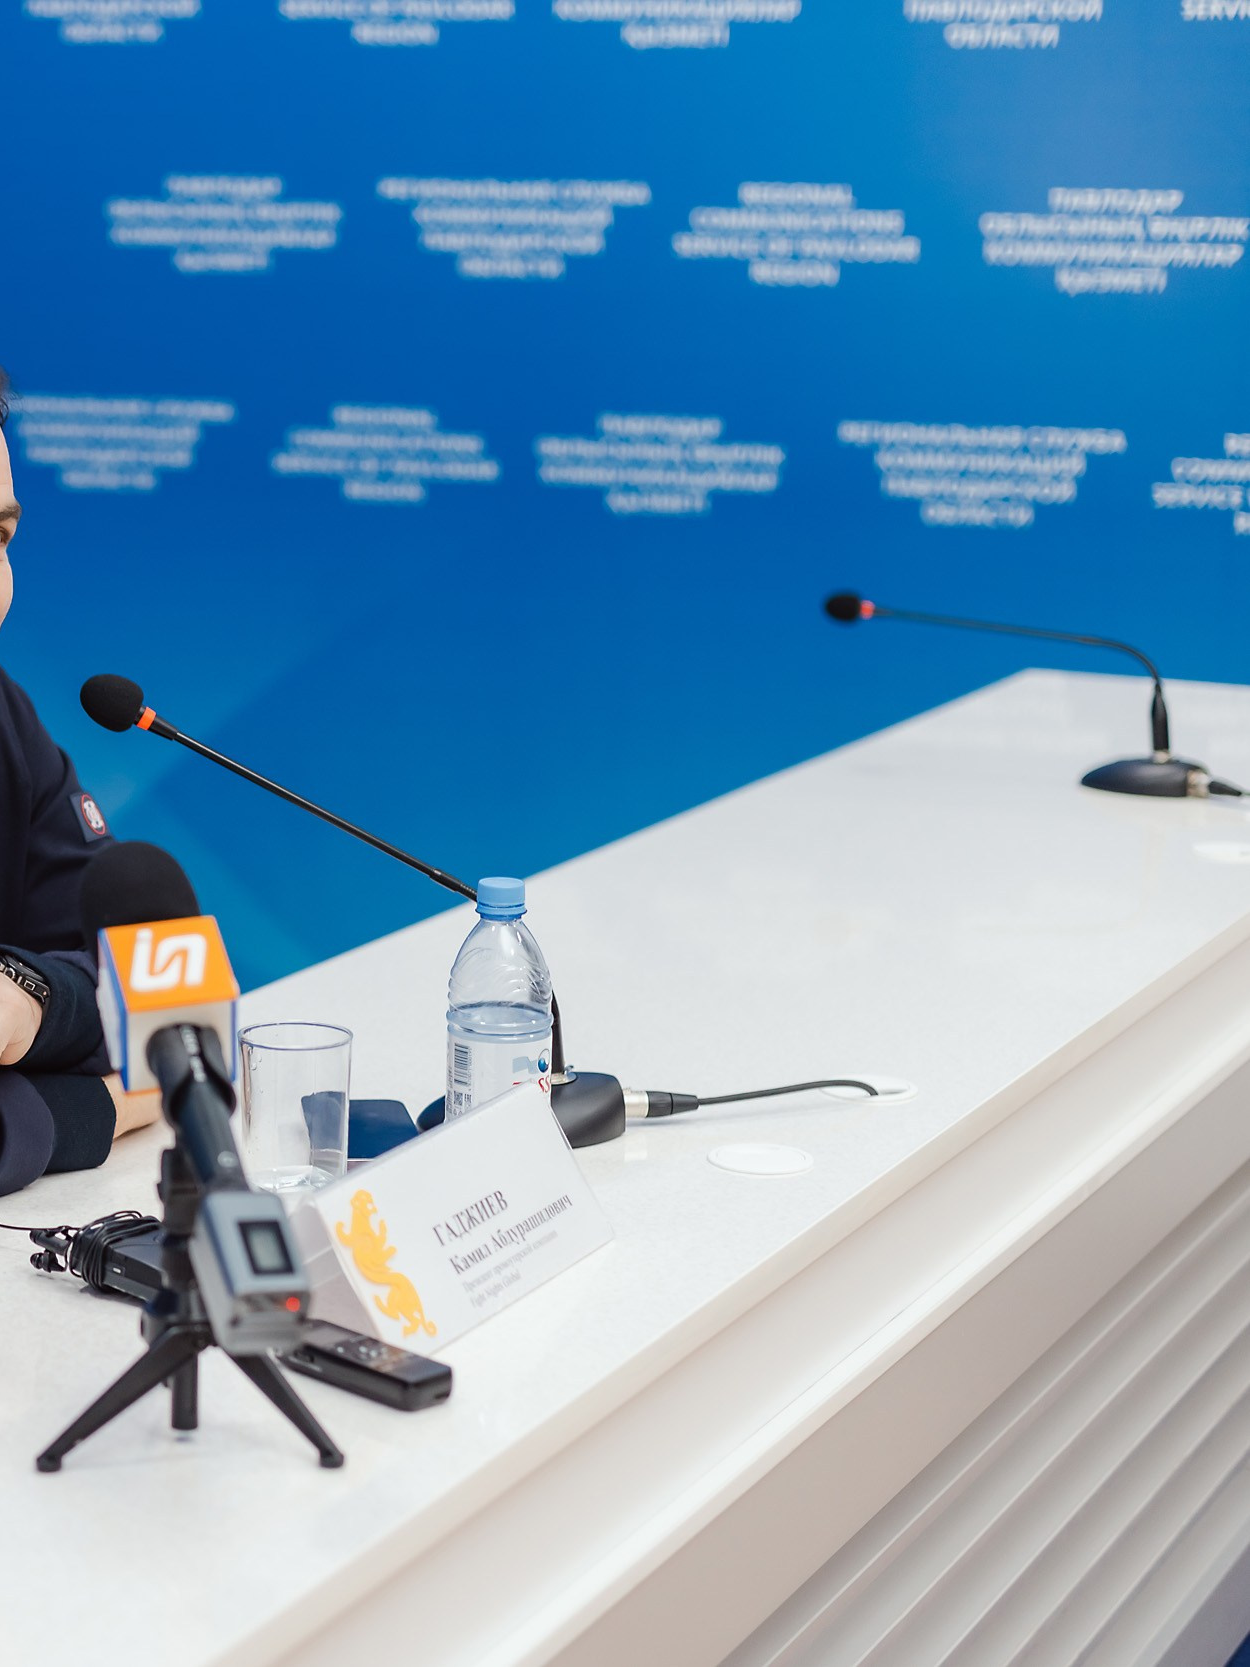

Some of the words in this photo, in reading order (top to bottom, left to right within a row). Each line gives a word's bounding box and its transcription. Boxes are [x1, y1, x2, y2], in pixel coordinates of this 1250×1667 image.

[432, 1190, 508, 1247] ГАДЖИЕВ
[449, 1243, 493, 1275] Камил
[490, 1194, 573, 1253] Абдурашидович
